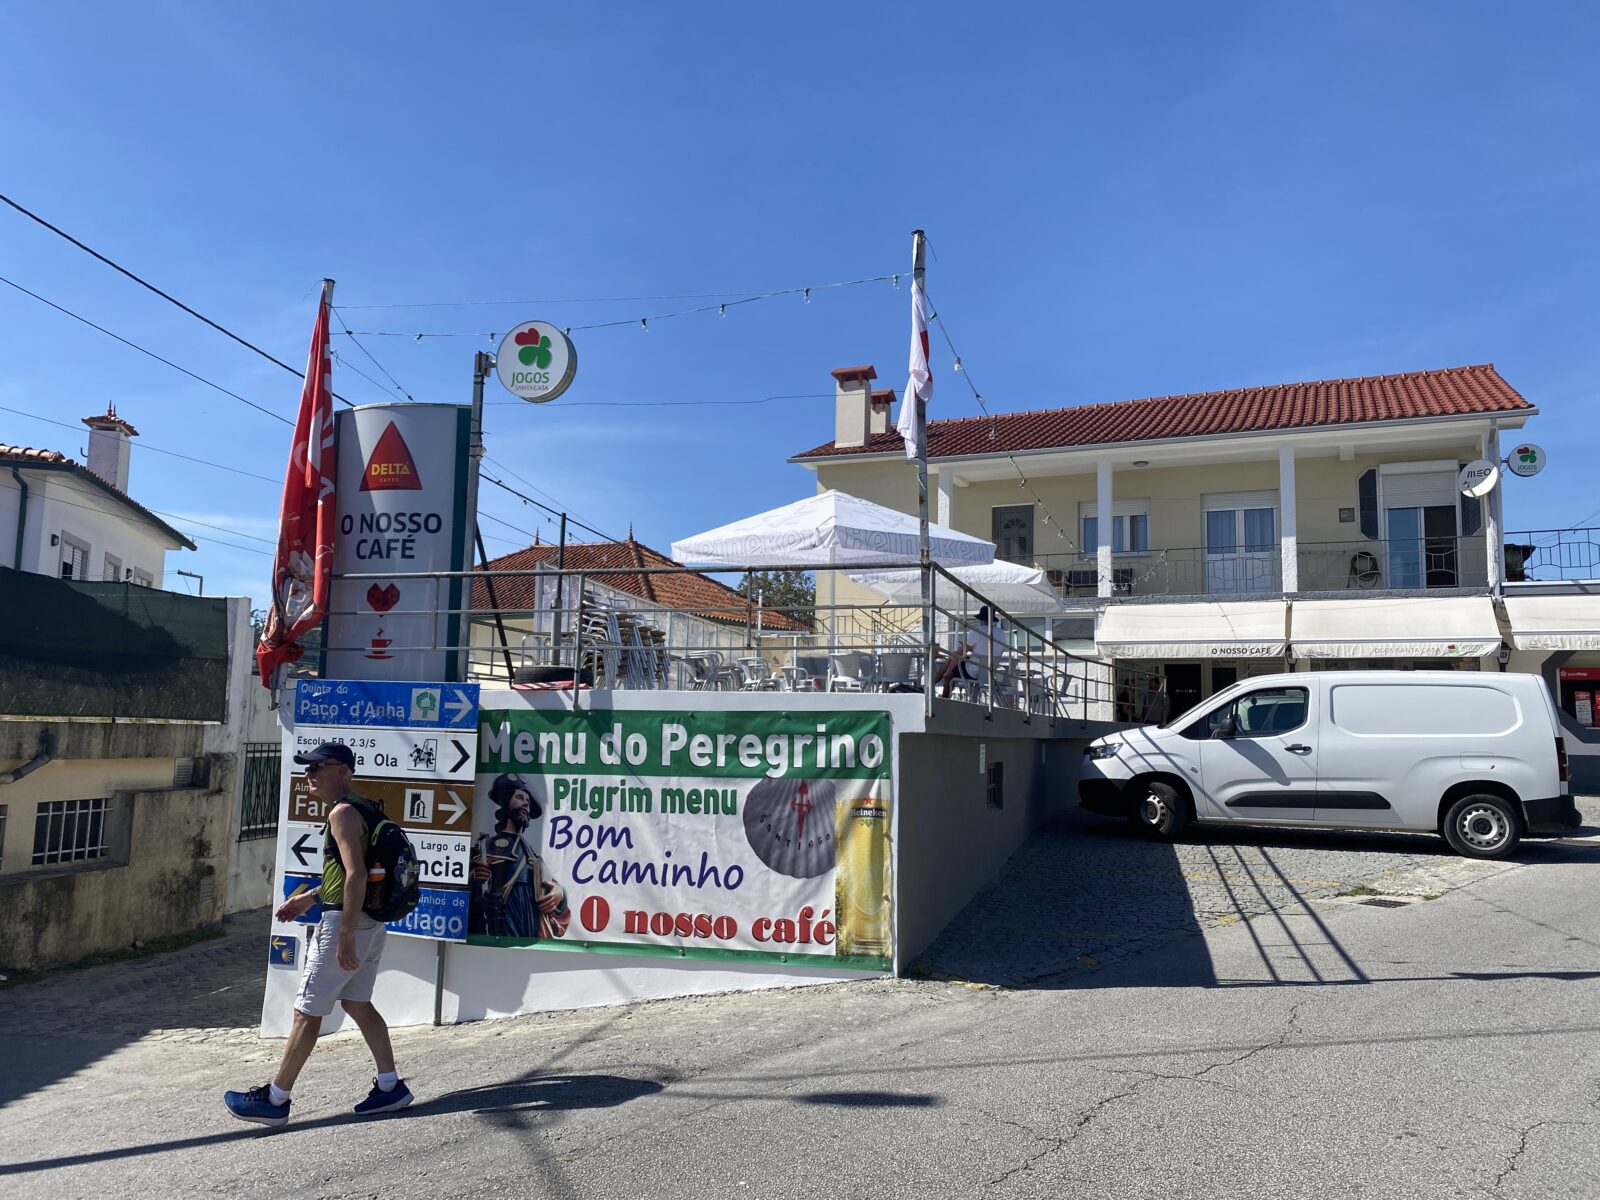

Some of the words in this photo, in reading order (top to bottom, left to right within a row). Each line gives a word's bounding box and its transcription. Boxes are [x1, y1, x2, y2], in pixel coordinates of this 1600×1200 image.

[511, 372, 550, 387] JOGOS
[1467, 468, 1491, 478] MEO
[1517, 464, 1537, 473] JOGOS
[341, 514, 354, 535] O
[360, 512, 442, 533] NOSSO
[356, 535, 416, 560] CAFÉ
[301, 683, 332, 694] Quinta
[336, 685, 348, 694] do
[301, 700, 339, 718] Paço
[351, 700, 405, 719] d'Anha
[297, 736, 326, 745] Escola
[481, 721, 587, 764] Menu
[600, 723, 648, 766] do
[661, 723, 884, 778] Peregrino
[374, 753, 398, 767] Ola
[553, 778, 653, 819] Pilgrim
[660, 787, 737, 816] menu
[850, 808, 887, 819] Heineken
[549, 815, 634, 850] Bom
[421, 840, 449, 852] Largo
[454, 842, 466, 852] da
[418, 856, 464, 878] ncia
[571, 850, 744, 890] Caminho
[418, 894, 446, 906] inhos
[452, 897, 465, 907] de
[384, 907, 464, 936] tiago
[580, 895, 611, 933] O
[622, 909, 738, 940] nosso
[751, 905, 836, 946] café
